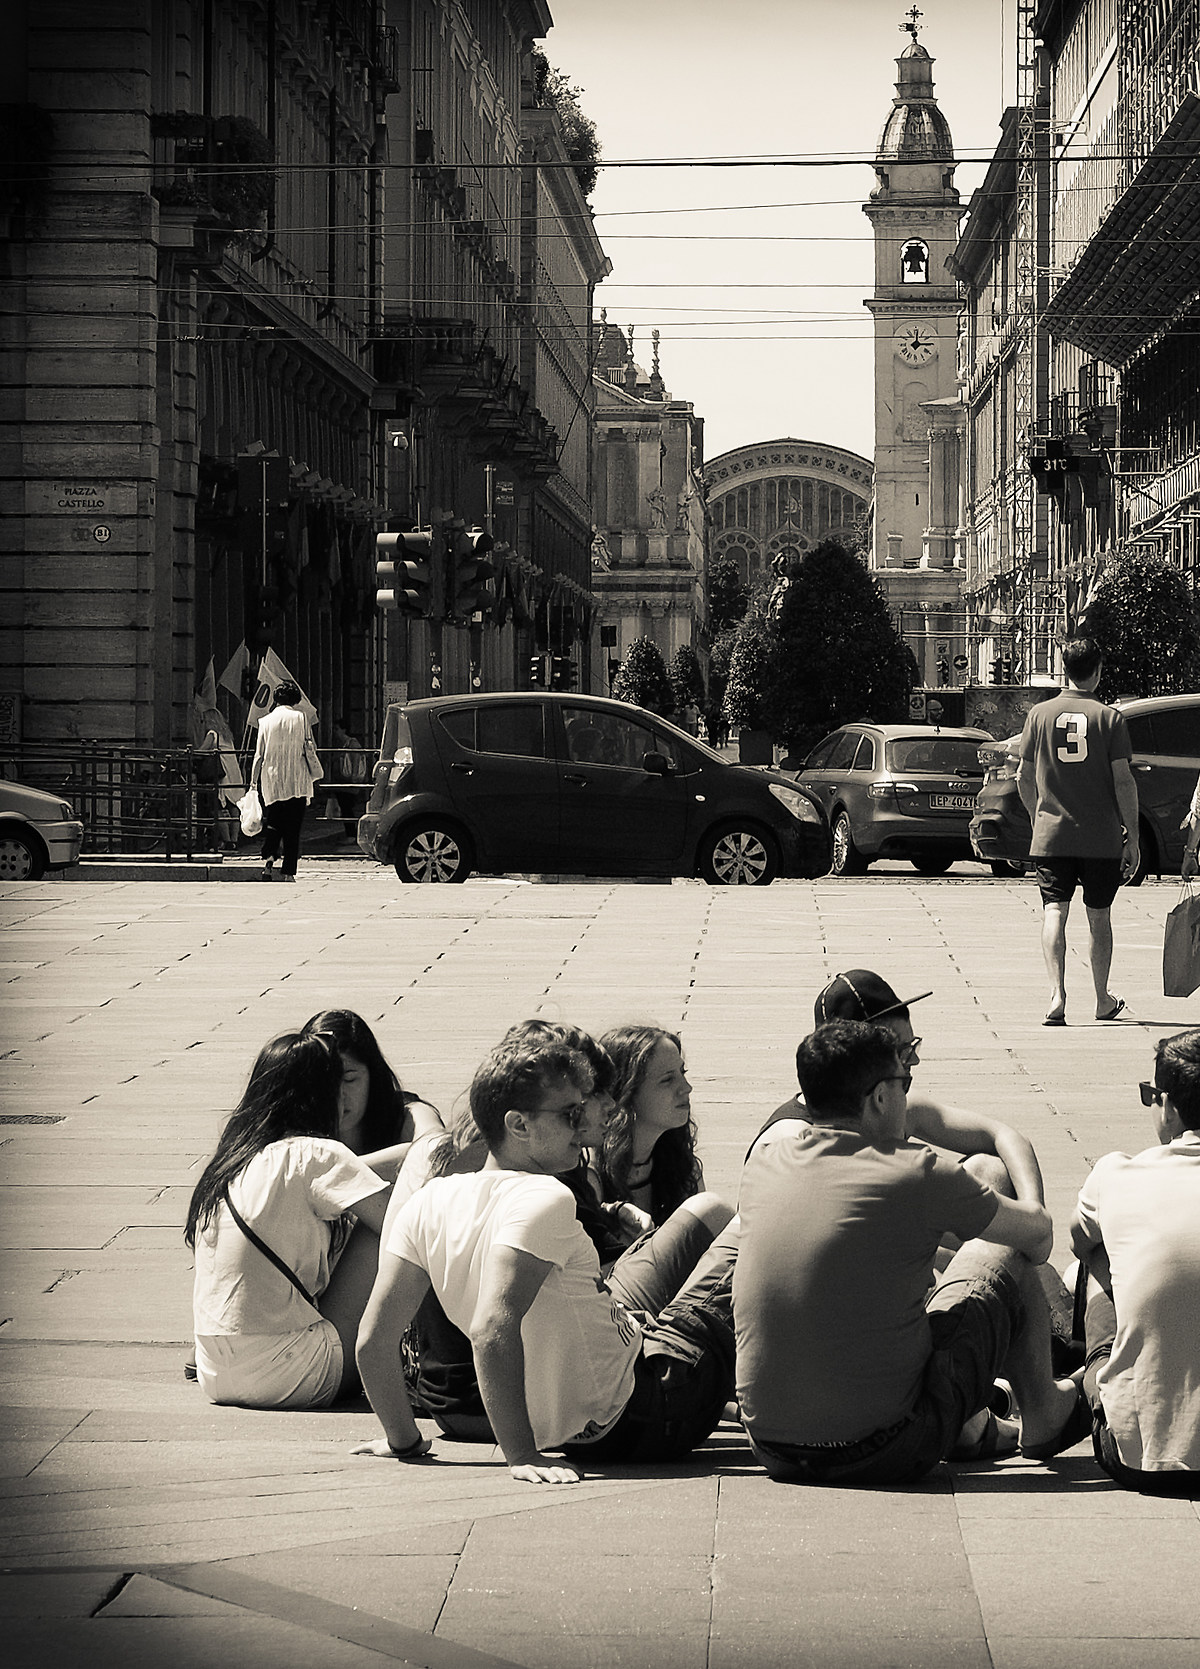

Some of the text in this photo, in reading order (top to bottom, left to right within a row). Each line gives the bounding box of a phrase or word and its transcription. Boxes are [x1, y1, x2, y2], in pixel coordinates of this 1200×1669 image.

[64, 487, 97, 496] PIAZZA
[57, 499, 105, 508] CASTELLO
[1055, 711, 1089, 764] 3
[937, 796, 949, 806] EP
